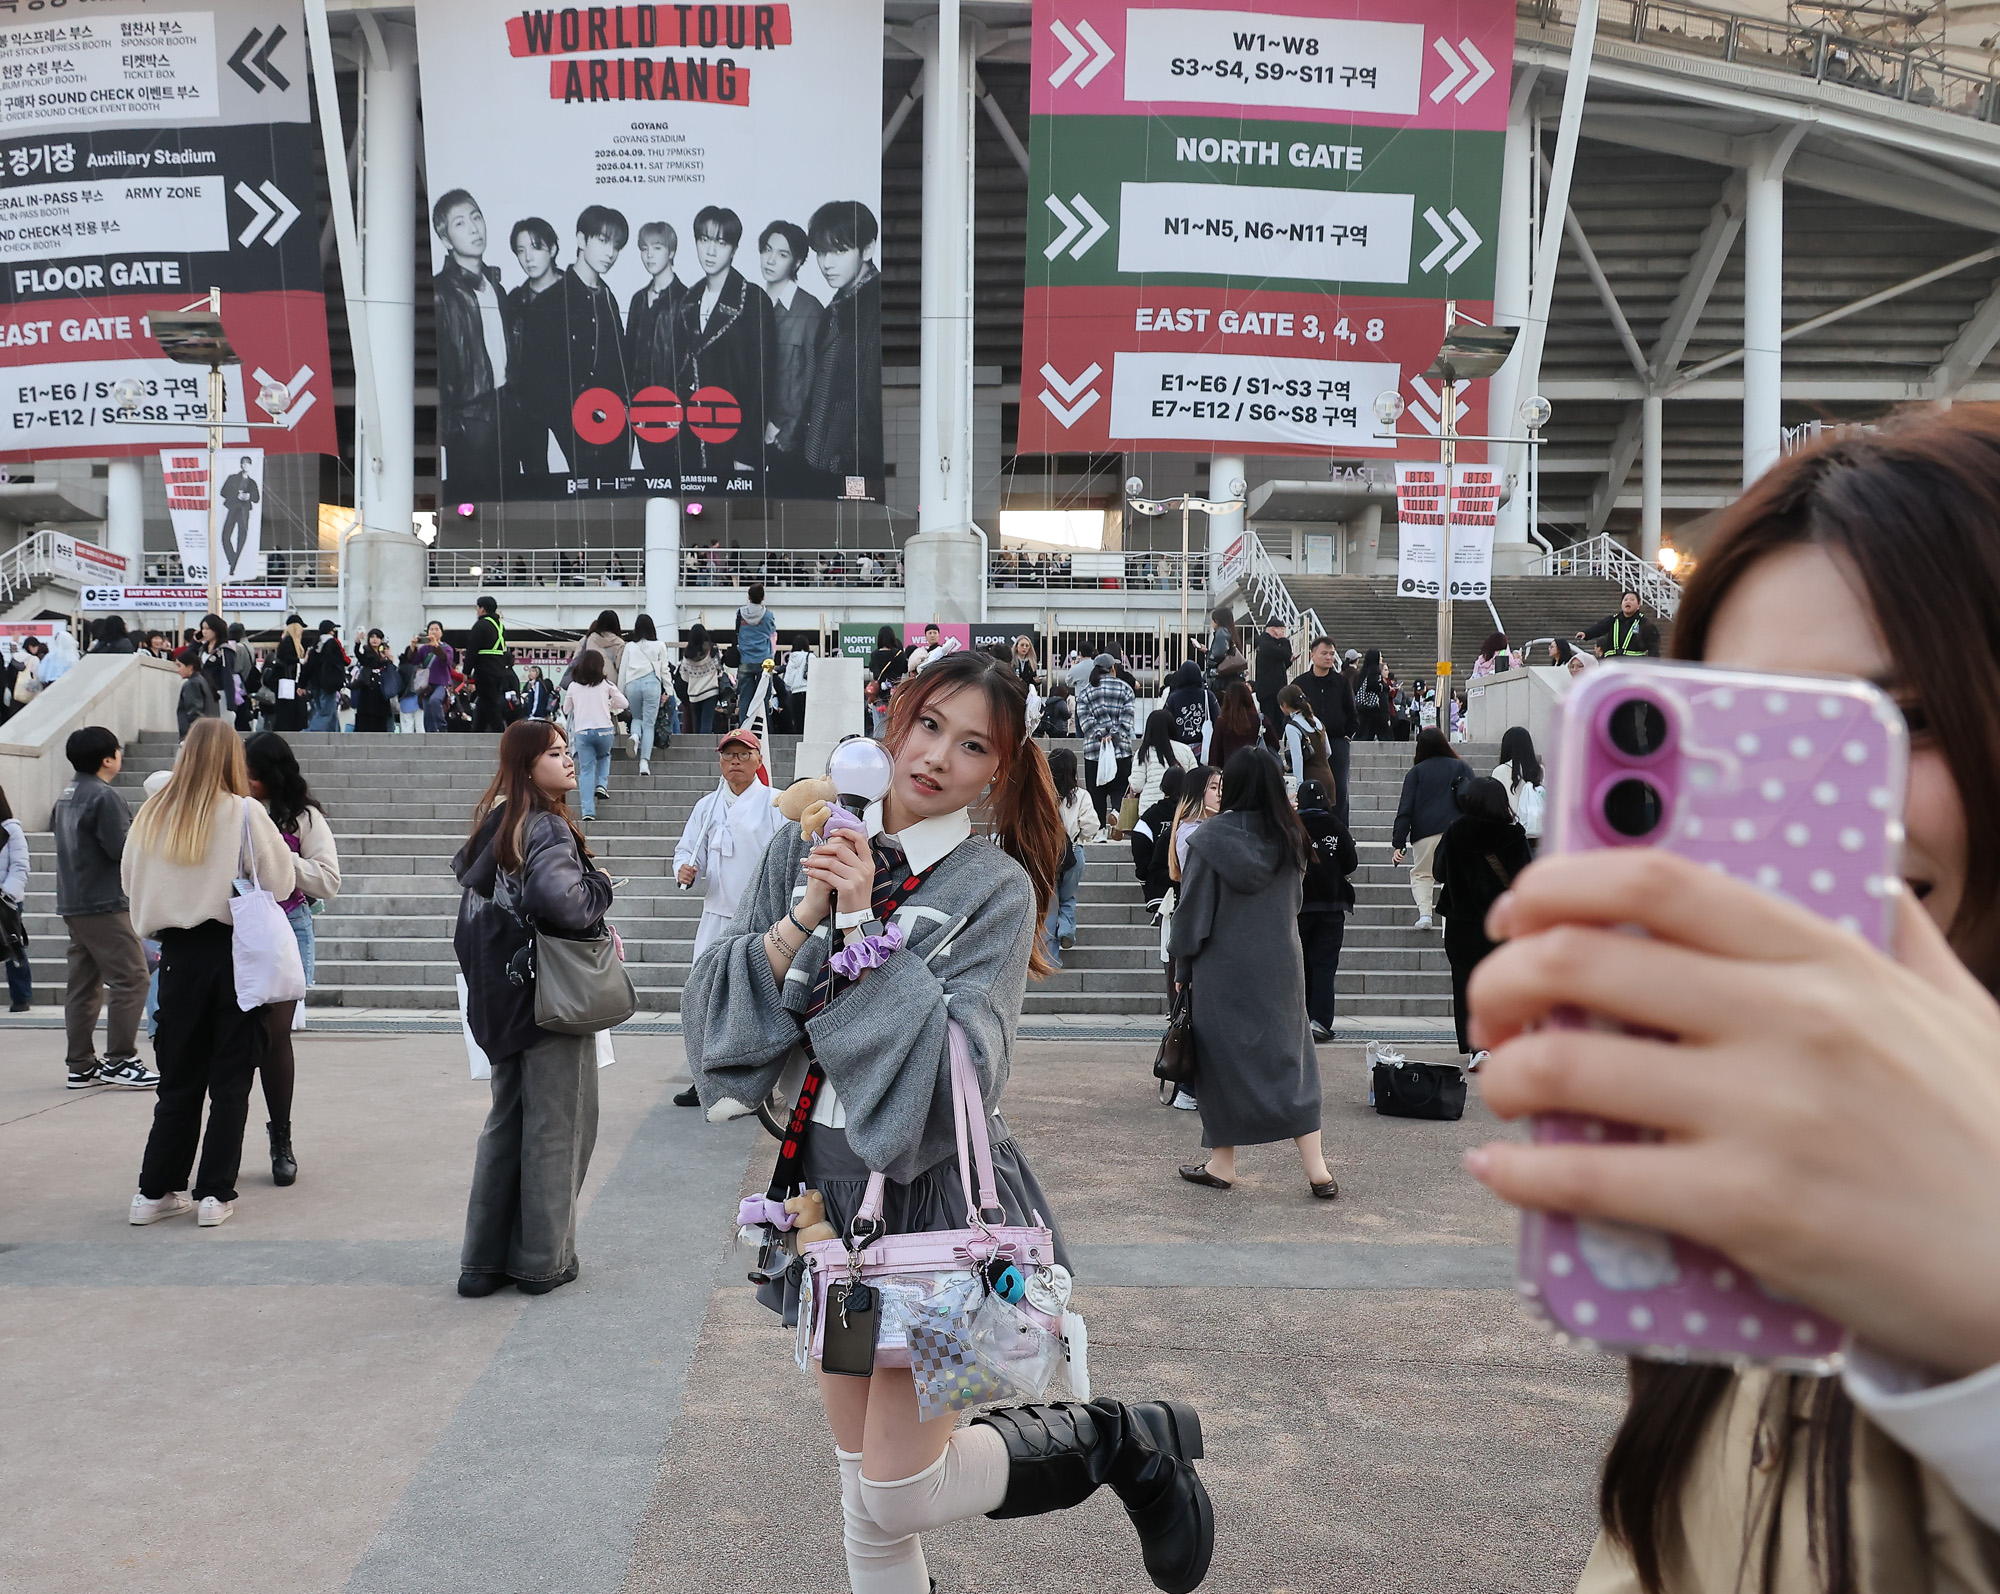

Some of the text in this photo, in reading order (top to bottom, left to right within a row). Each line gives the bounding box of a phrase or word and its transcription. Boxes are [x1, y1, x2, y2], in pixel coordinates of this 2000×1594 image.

[11, 28, 67, 46] 익스프레스
[70, 25, 93, 40] 부스
[121, 21, 182, 36] 협찬사 부스
[521, 4, 775, 54] WORLD TOUR
[15, 47, 39, 57] STICK
[41, 42, 80, 54] EXPRESS
[82, 40, 112, 49] BOOTH
[121, 37, 197, 47] SPONSOR BOOTH
[1233, 32, 1319, 56] W1~W8
[122, 54, 170, 68] 티켓박스
[2, 63, 22, 79] 현장
[51, 59, 75, 74] 부스
[123, 70, 175, 79] TICKET BOX
[1170, 57, 1377, 89] S3~S4, S9~S11 구역
[0, 74, 87, 91] BUM PICKUP BOOTH
[564, 56, 737, 104] ARIRANG
[4, 94, 35, 111] 구매자
[38, 91, 87, 106] SOUND
[90, 88, 135, 102] CHECK
[138, 86, 175, 101] 이벤트
[177, 85, 200, 100] 부스
[34, 107, 66, 118] SOUND
[68, 104, 99, 116] CHECK
[100, 103, 127, 113] EVENT
[128, 102, 160, 112] BOOTH
[630, 122, 669, 130] GOYANG
[613, 134, 686, 144] GOYANG STADIUM
[594, 147, 705, 158] 2026.04.09. THU 7PM(KST)
[1175, 136, 1363, 171] NORTH GATE
[8, 143, 76, 177] 경기장
[86, 150, 151, 168] Auxiliary
[154, 148, 216, 165] Stadium
[596, 160, 704, 171] 2026.04.11. SAT 7PM(KST)
[595, 174, 706, 184] 2026.04.12. SUN 7PM(KST)
[26, 191, 79, 206] IN-PASS
[81, 190, 104, 203] 부스
[125, 186, 202, 199] ARMY ZONE
[40, 207, 70, 217] BOOTH
[101, 220, 121, 233] 부스
[1164, 217, 1368, 247] N1~N5, N6~N11 구역
[3, 243, 31, 253] CHECK
[33, 240, 61, 250] BOOTH
[15, 260, 182, 294] FLOOR GATE
[60, 316, 132, 343] GATE
[1135, 307, 1385, 345] EAST GATE 3, 4, 8
[18, 383, 77, 404] E1~E6
[164, 377, 198, 398] 구역
[1160, 374, 1351, 401] E1~E6 / S1~S3 구역
[13, 408, 84, 429] E7~E12
[1151, 400, 1358, 428] E7~E12 / S6~S8 구역
[681, 475, 717, 483] SAMSUNG
[1332, 466, 1377, 482] EAST
[1409, 472, 1431, 483] BTS
[1467, 473, 1488, 483] BTS
[644, 478, 672, 489] VISA
[681, 483, 705, 492] Galaxy
[1402, 485, 1439, 497] WORLD
[1459, 486, 1495, 498] WORLD
[1405, 500, 1434, 511] TOUR
[1461, 501, 1488, 511] TOUR
[1401, 512, 1445, 526] ARIRANG
[1452, 513, 1496, 526] ARIRANG
[843, 636, 876, 644] NORTH
[975, 636, 1006, 644] FLOOR
[847, 645, 872, 653] GATE
